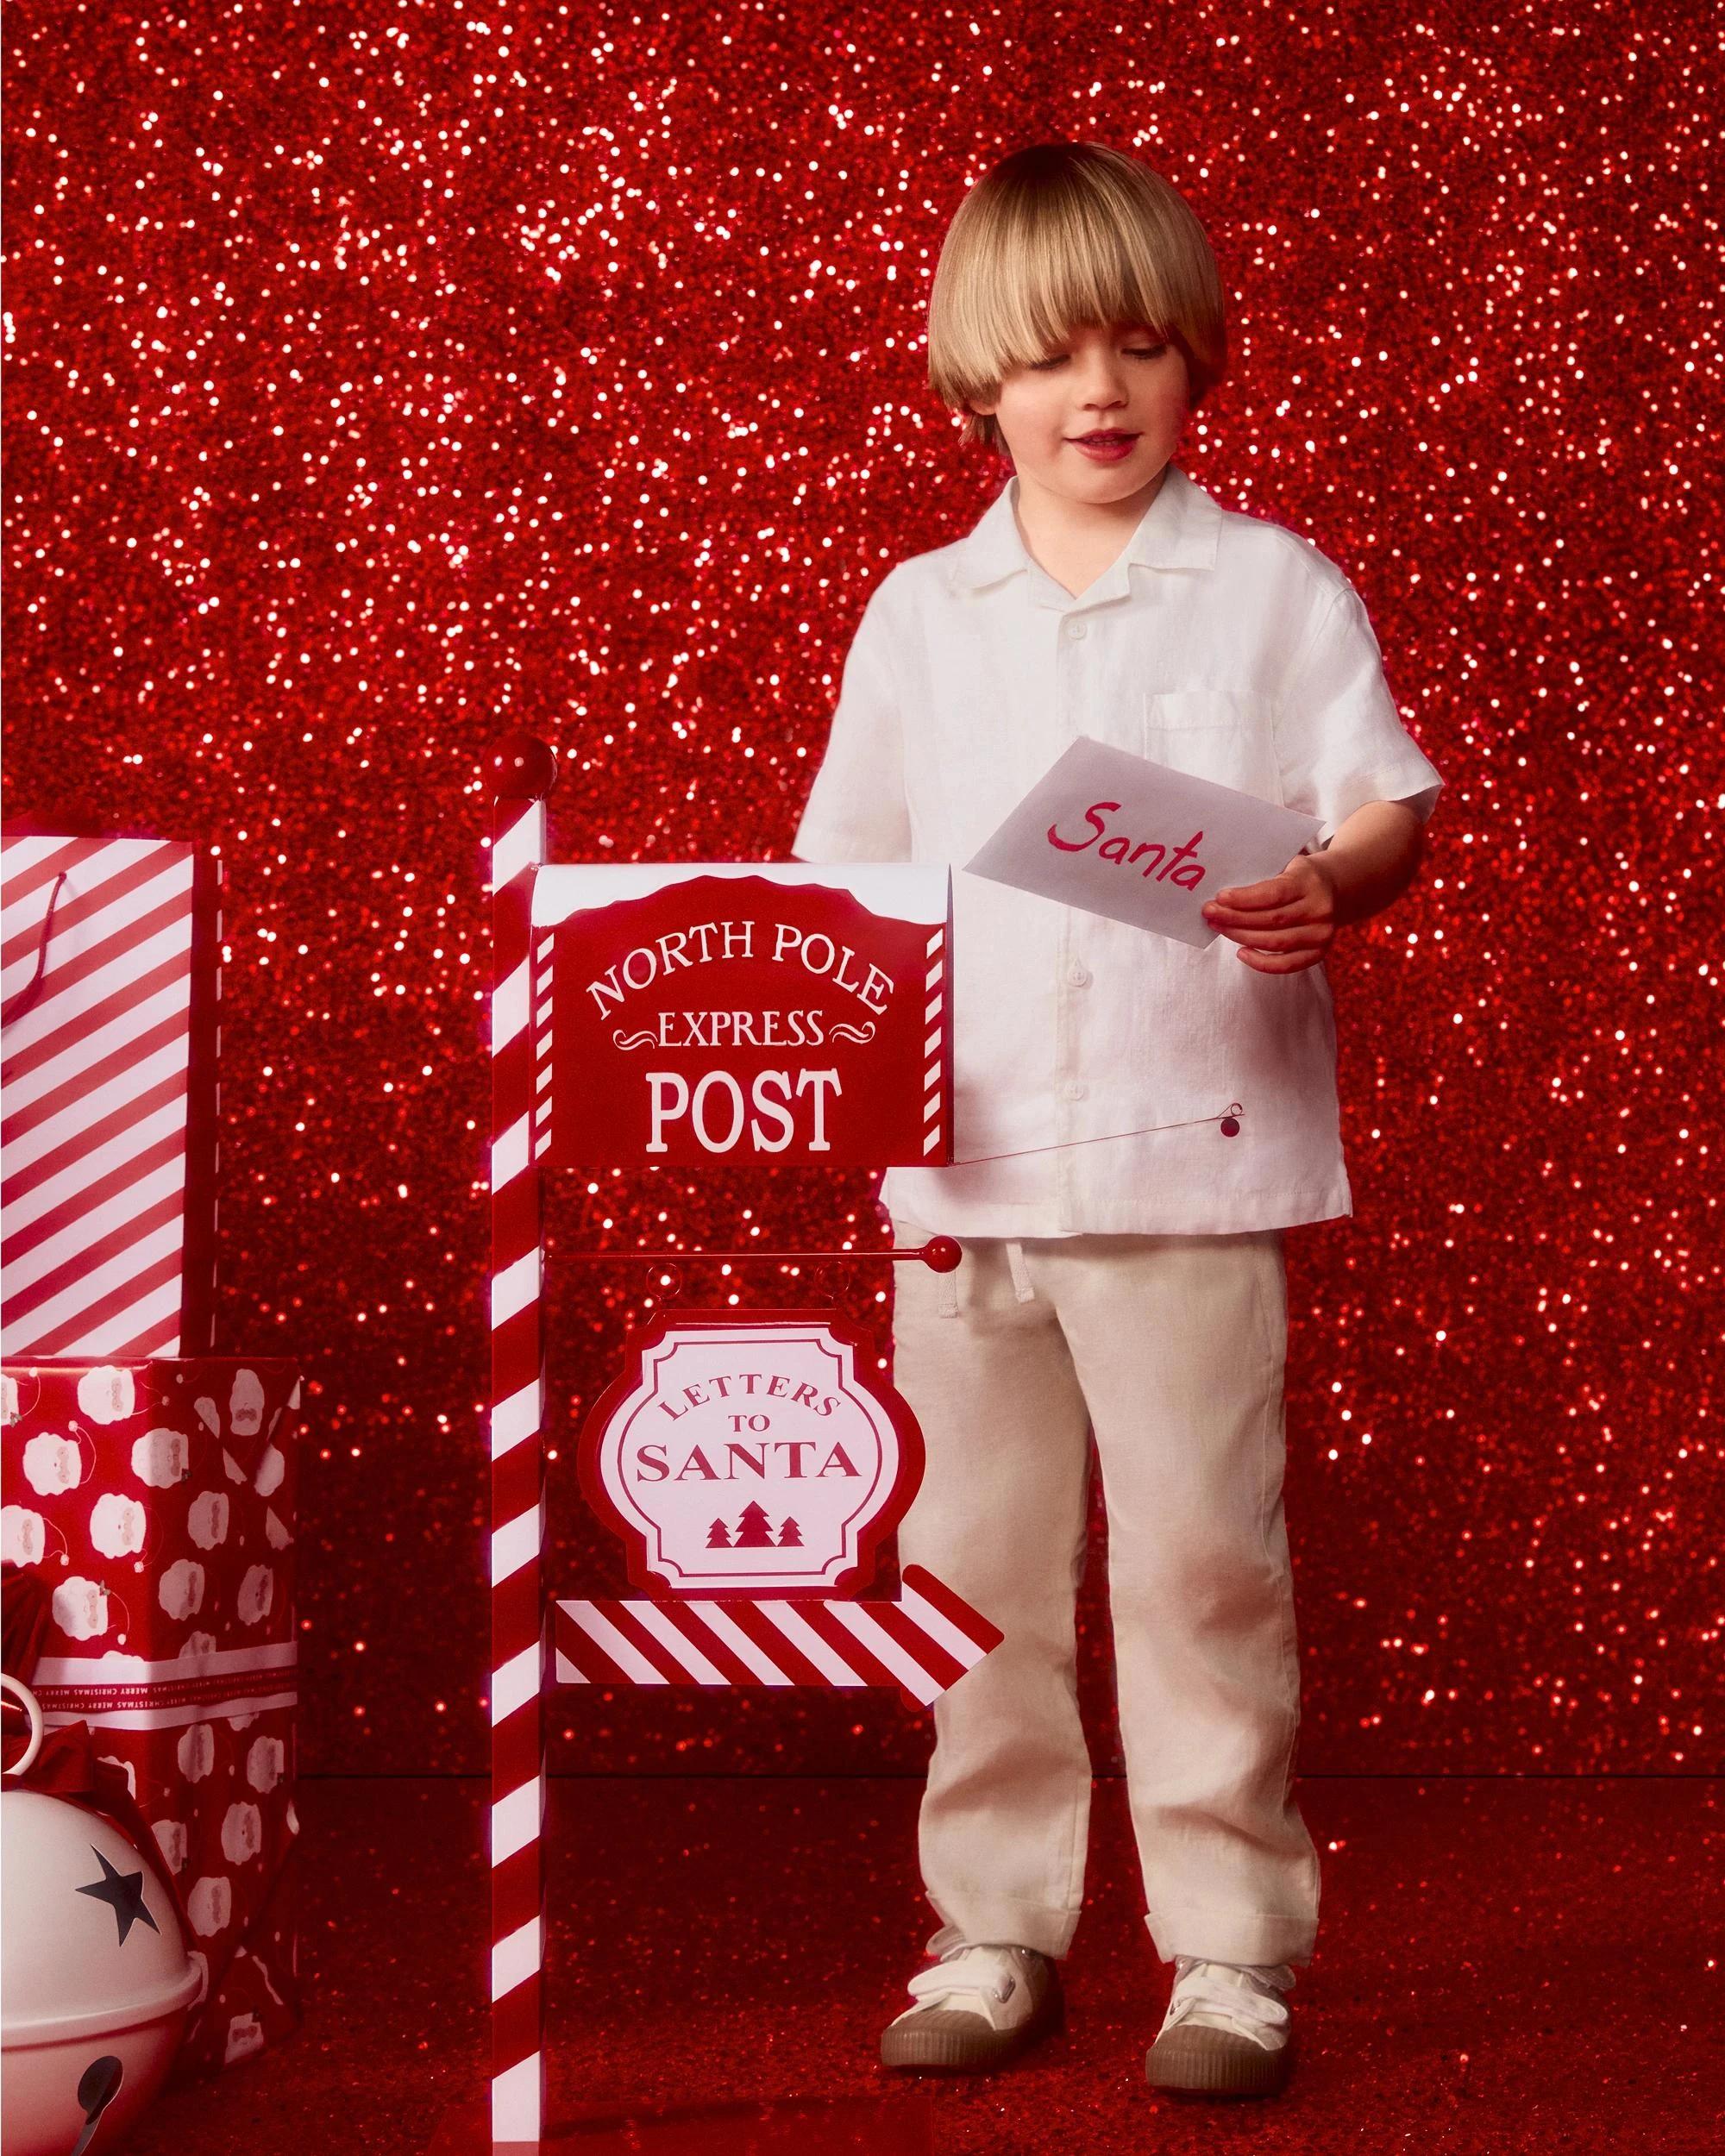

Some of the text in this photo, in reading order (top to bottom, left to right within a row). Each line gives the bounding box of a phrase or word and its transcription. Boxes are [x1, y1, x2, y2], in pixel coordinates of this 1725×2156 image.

[1047, 801, 1206, 892] Santa
[586, 920, 894, 1021] NORTH POLE
[657, 1009, 824, 1047] EXPRESS
[645, 1068, 843, 1153] POST
[656, 1373, 842, 1422] LETTERS
[727, 1413, 771, 1432] TO
[636, 1441, 862, 1482] SANTA
[74, 1688, 117, 1696] CHRISTMAS
